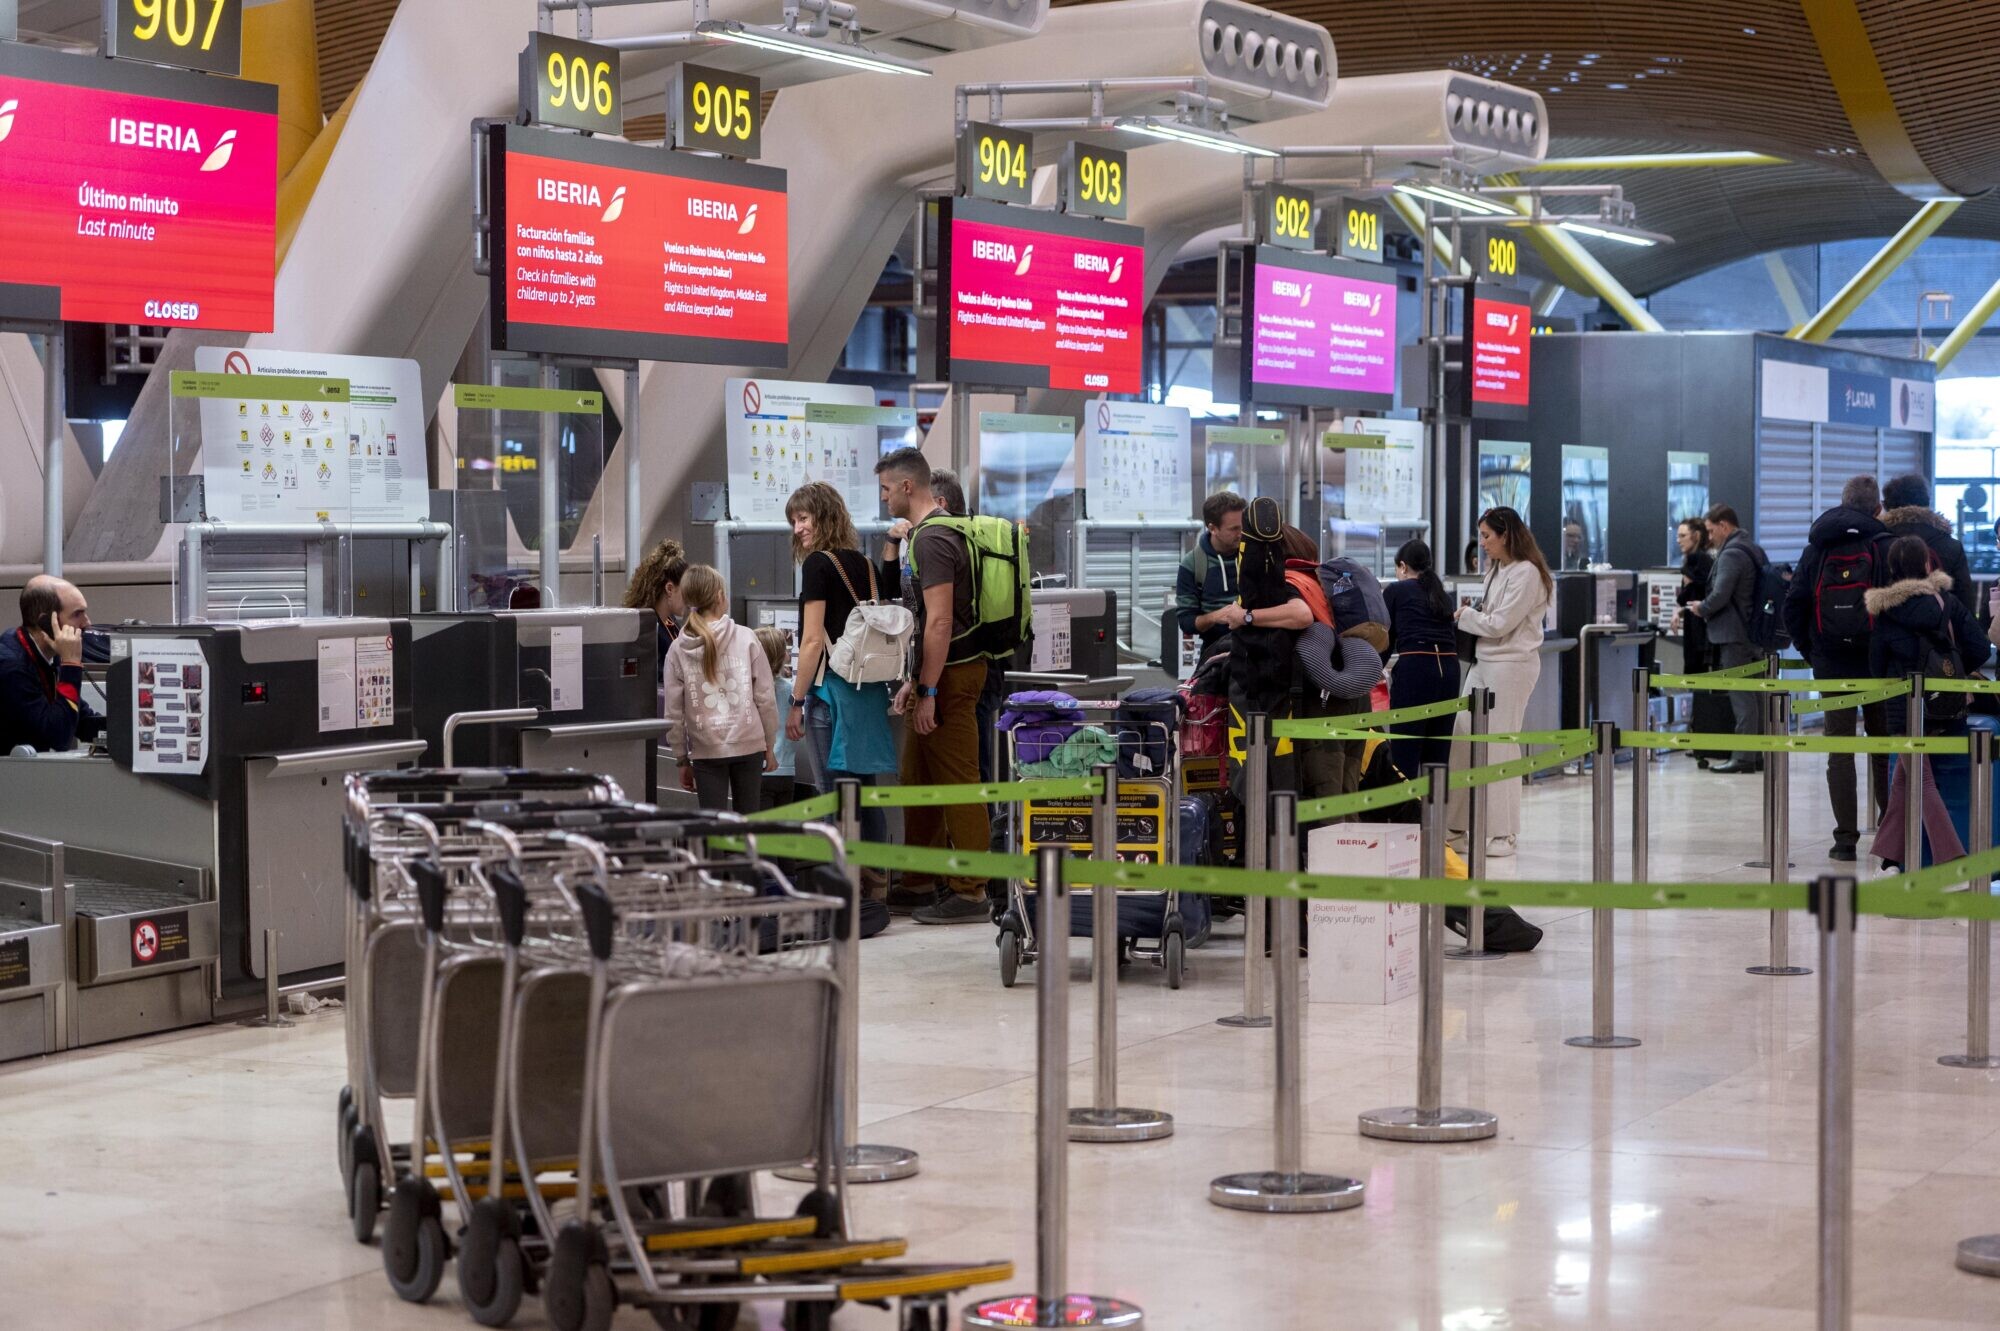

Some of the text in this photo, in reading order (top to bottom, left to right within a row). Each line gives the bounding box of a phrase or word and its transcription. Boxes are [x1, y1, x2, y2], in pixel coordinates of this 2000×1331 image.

[547, 52, 612, 115] 906
[692, 82, 751, 140] 905
[110, 117, 200, 153] IBERIA
[979, 136, 1027, 188] 904
[537, 178, 601, 207] IBERIA
[1080, 157, 1122, 205] 903
[78, 182, 178, 216] Último minuto
[687, 197, 738, 222] IBERIA
[77, 215, 155, 241] Last minute
[1275, 195, 1310, 238] 902
[517, 224, 594, 246] Facturación familias
[1348, 209, 1377, 251] 901
[517, 245, 603, 265] con niños hasta 2 años
[972, 240, 1016, 263] IBERIA
[1074, 252, 1110, 273] IBERIA
[1488, 237, 1516, 275] 900
[517, 267, 596, 287] Check in families with
[664, 281, 683, 296] Flights
[1272, 280, 1302, 298] IBERIA
[517, 286, 595, 308] children up to 2 years
[144, 301, 199, 321] CLOSED
[1313, 914, 1376, 925] Enjoy your flight!
